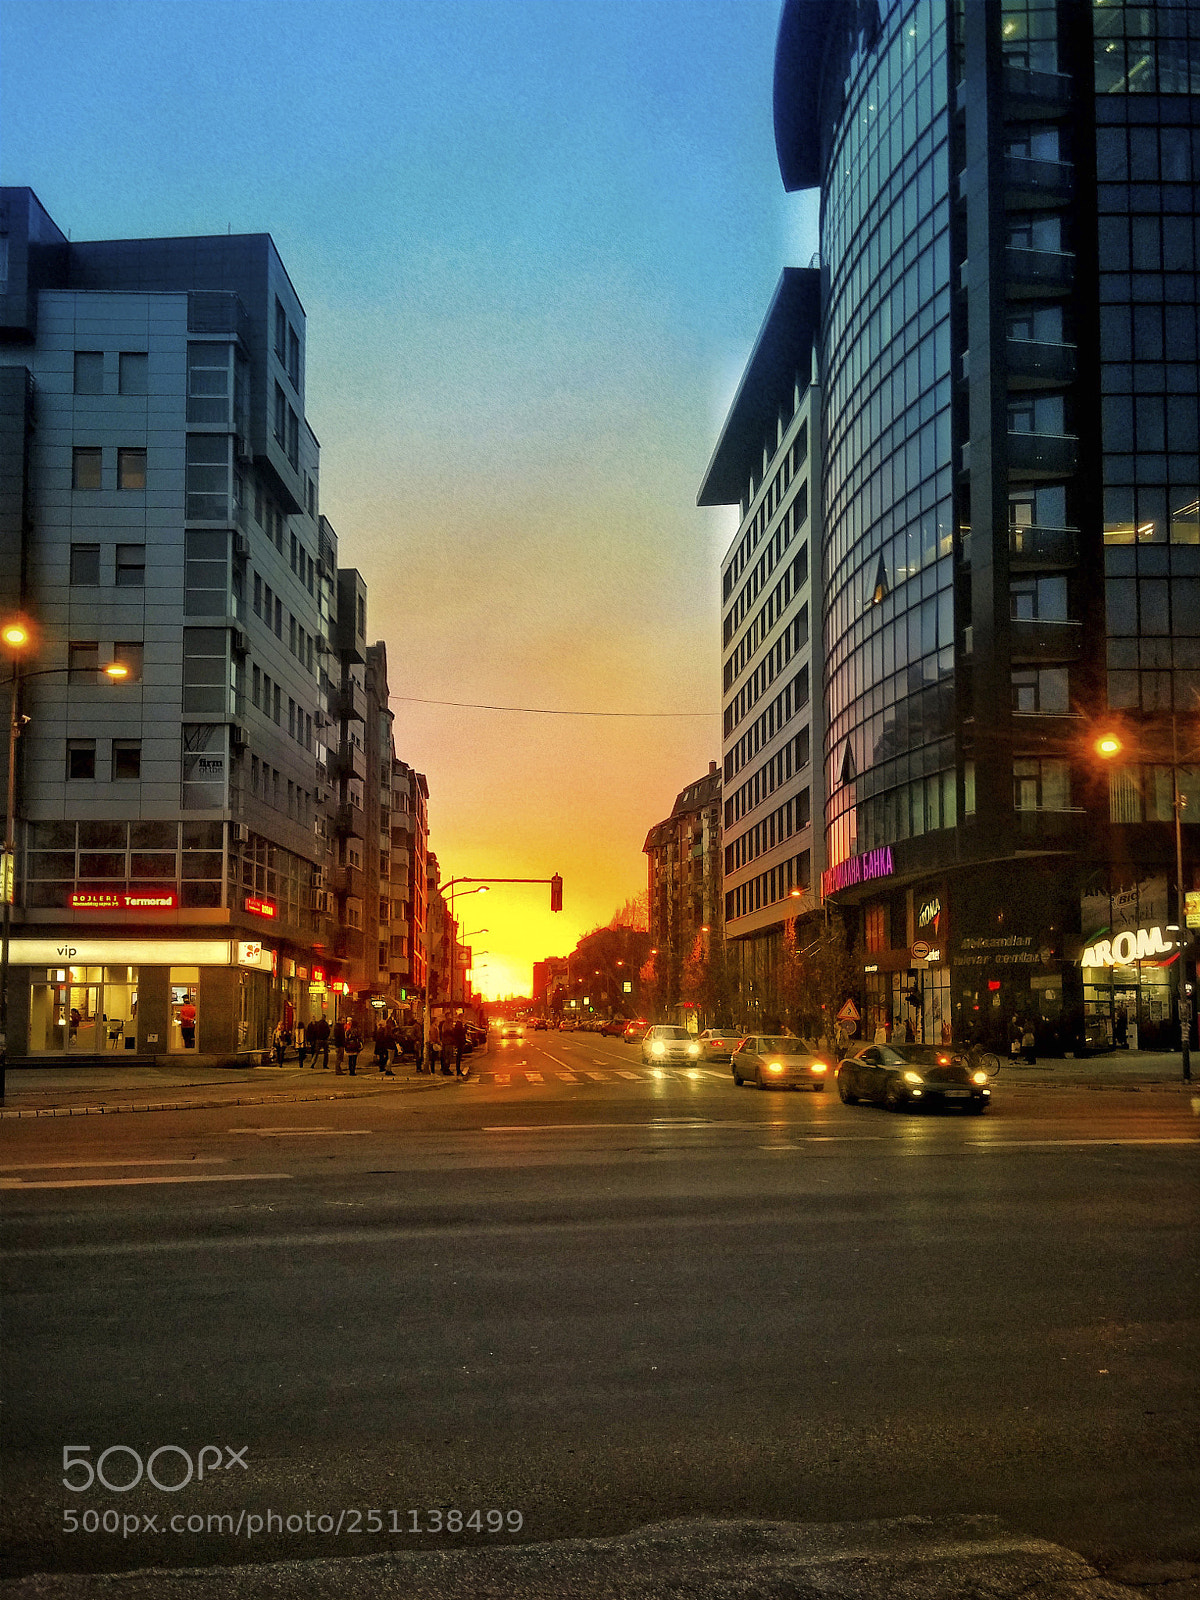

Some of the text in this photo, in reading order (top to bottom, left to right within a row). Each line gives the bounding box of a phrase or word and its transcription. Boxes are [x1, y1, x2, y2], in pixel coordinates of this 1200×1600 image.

[863, 846, 893, 881] БАНКА
[124, 896, 172, 906] Termorad
[56, 944, 77, 959] vip
